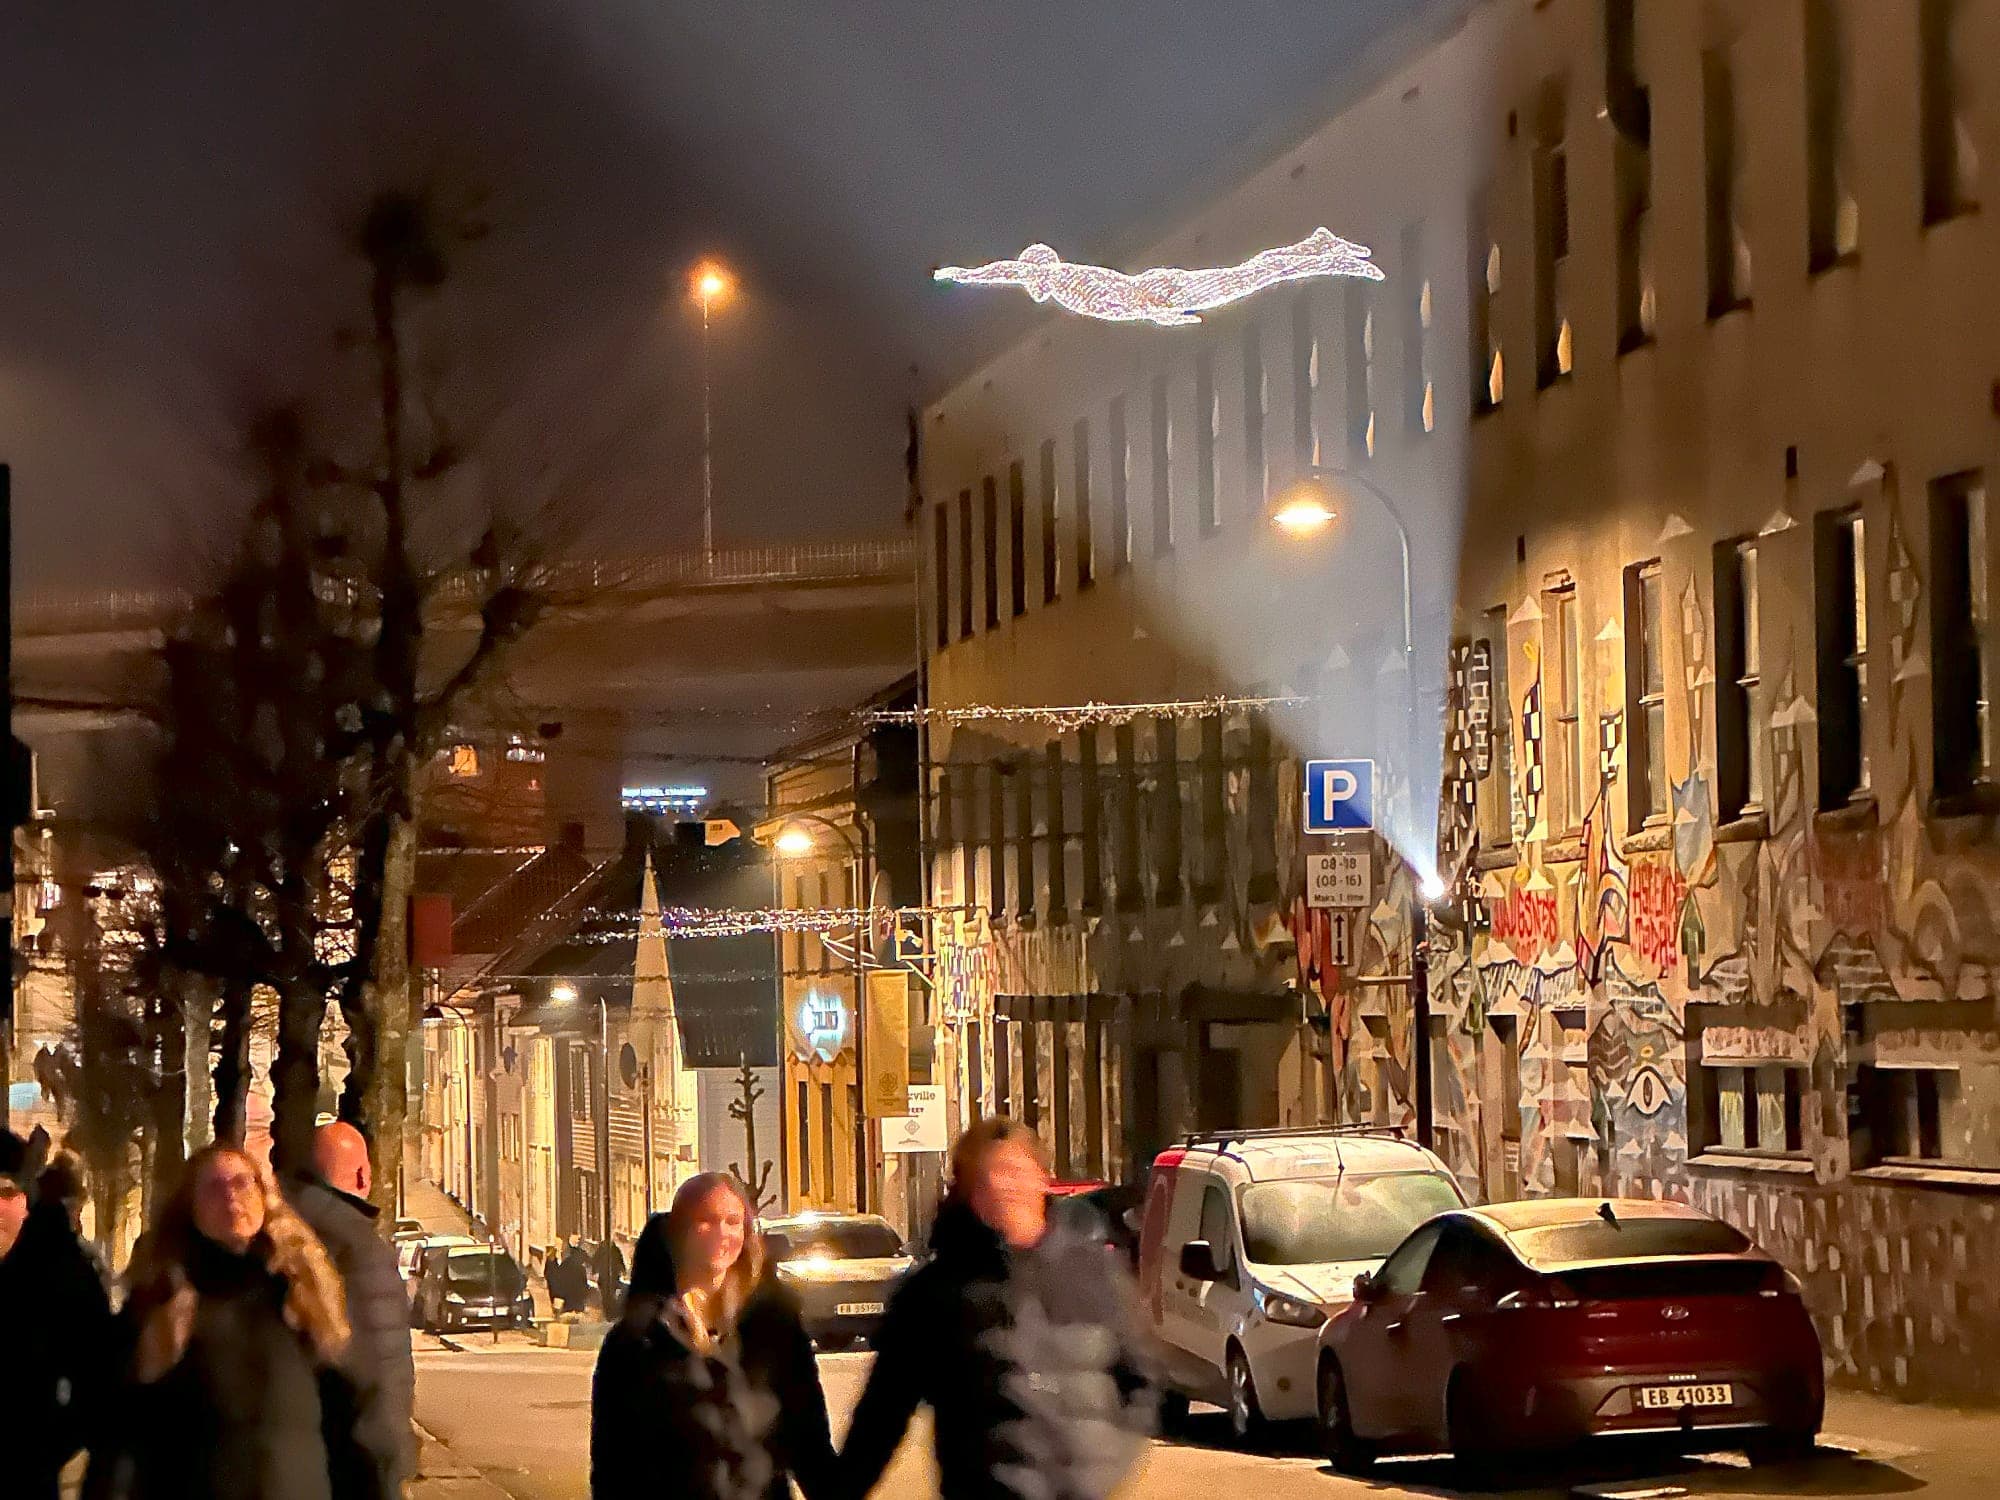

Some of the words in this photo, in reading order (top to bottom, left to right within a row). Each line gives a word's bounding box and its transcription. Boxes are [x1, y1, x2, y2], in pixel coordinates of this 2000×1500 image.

[1323, 770, 1358, 821] P
[1648, 1389, 1669, 1406] EB
[1676, 1386, 1726, 1404] 41033
